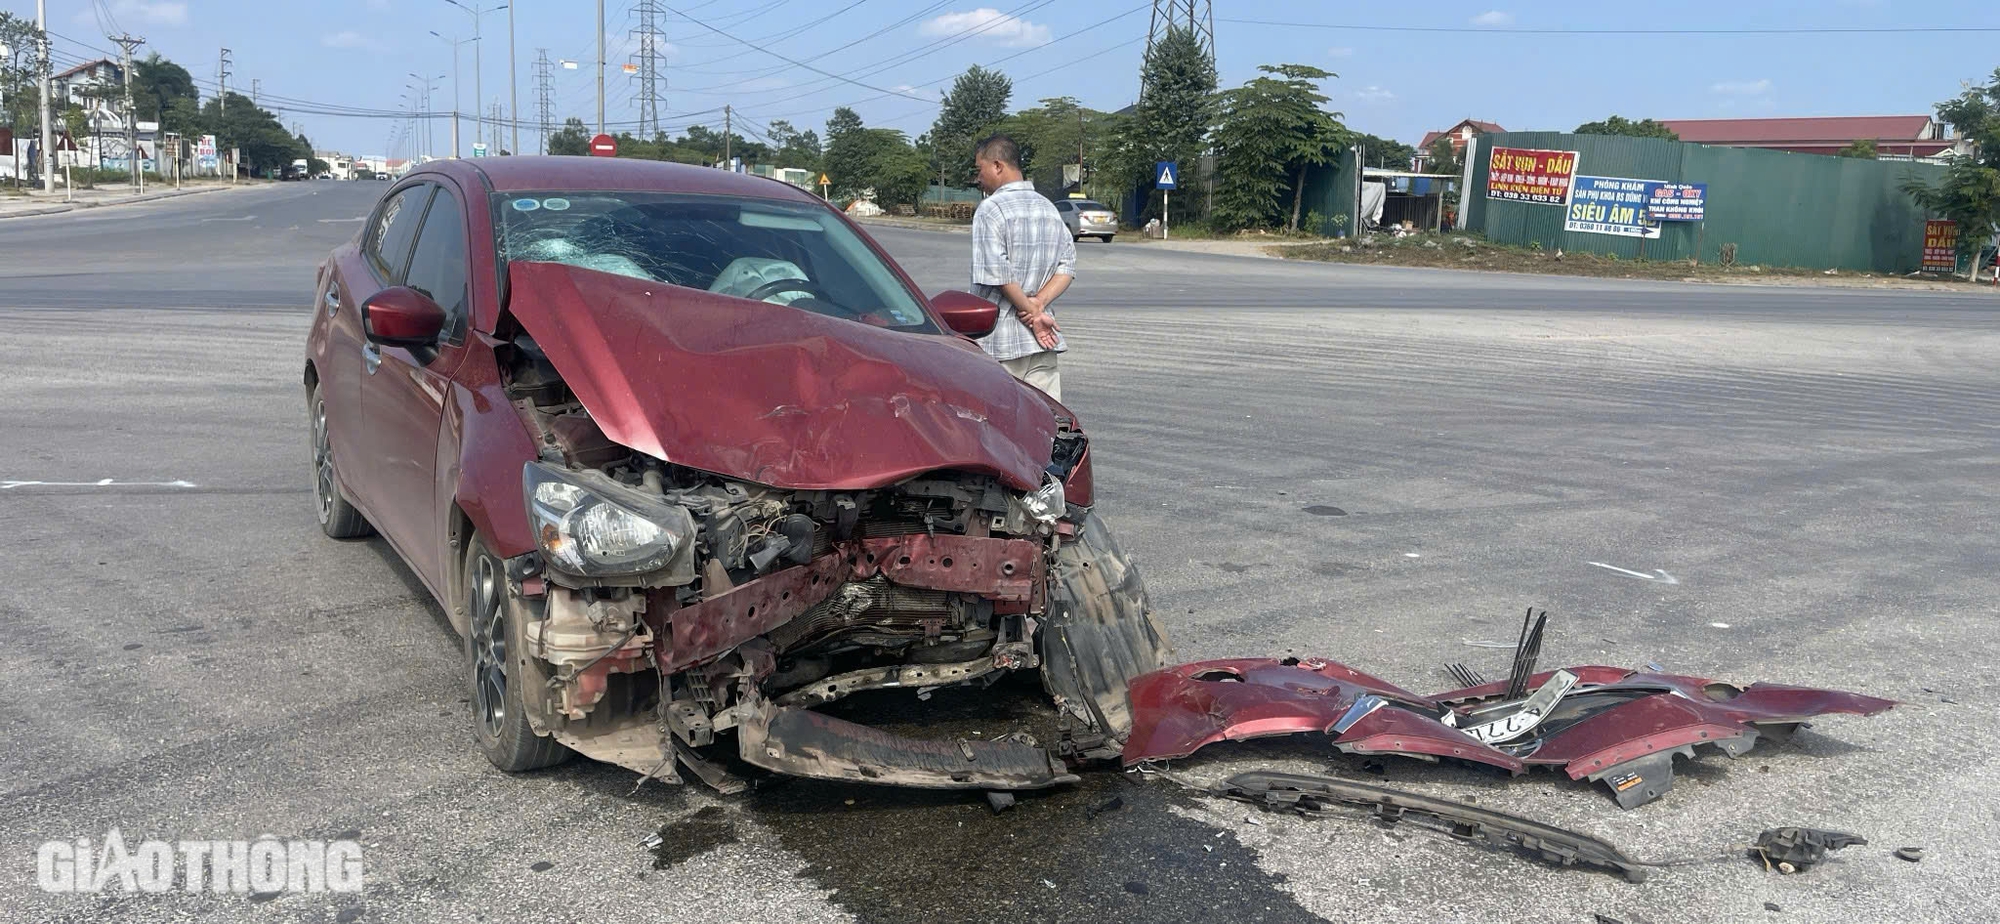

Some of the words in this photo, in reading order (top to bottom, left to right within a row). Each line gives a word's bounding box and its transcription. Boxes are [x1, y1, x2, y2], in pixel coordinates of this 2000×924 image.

[1492, 150, 1513, 170] SẮT
[1547, 153, 1571, 174] DẦU
[1621, 181, 1645, 192] KHÁM
[1654, 188, 1675, 198] GAS
[1571, 202, 1606, 221] SIÊU
[1608, 204, 1635, 224] ÂM
